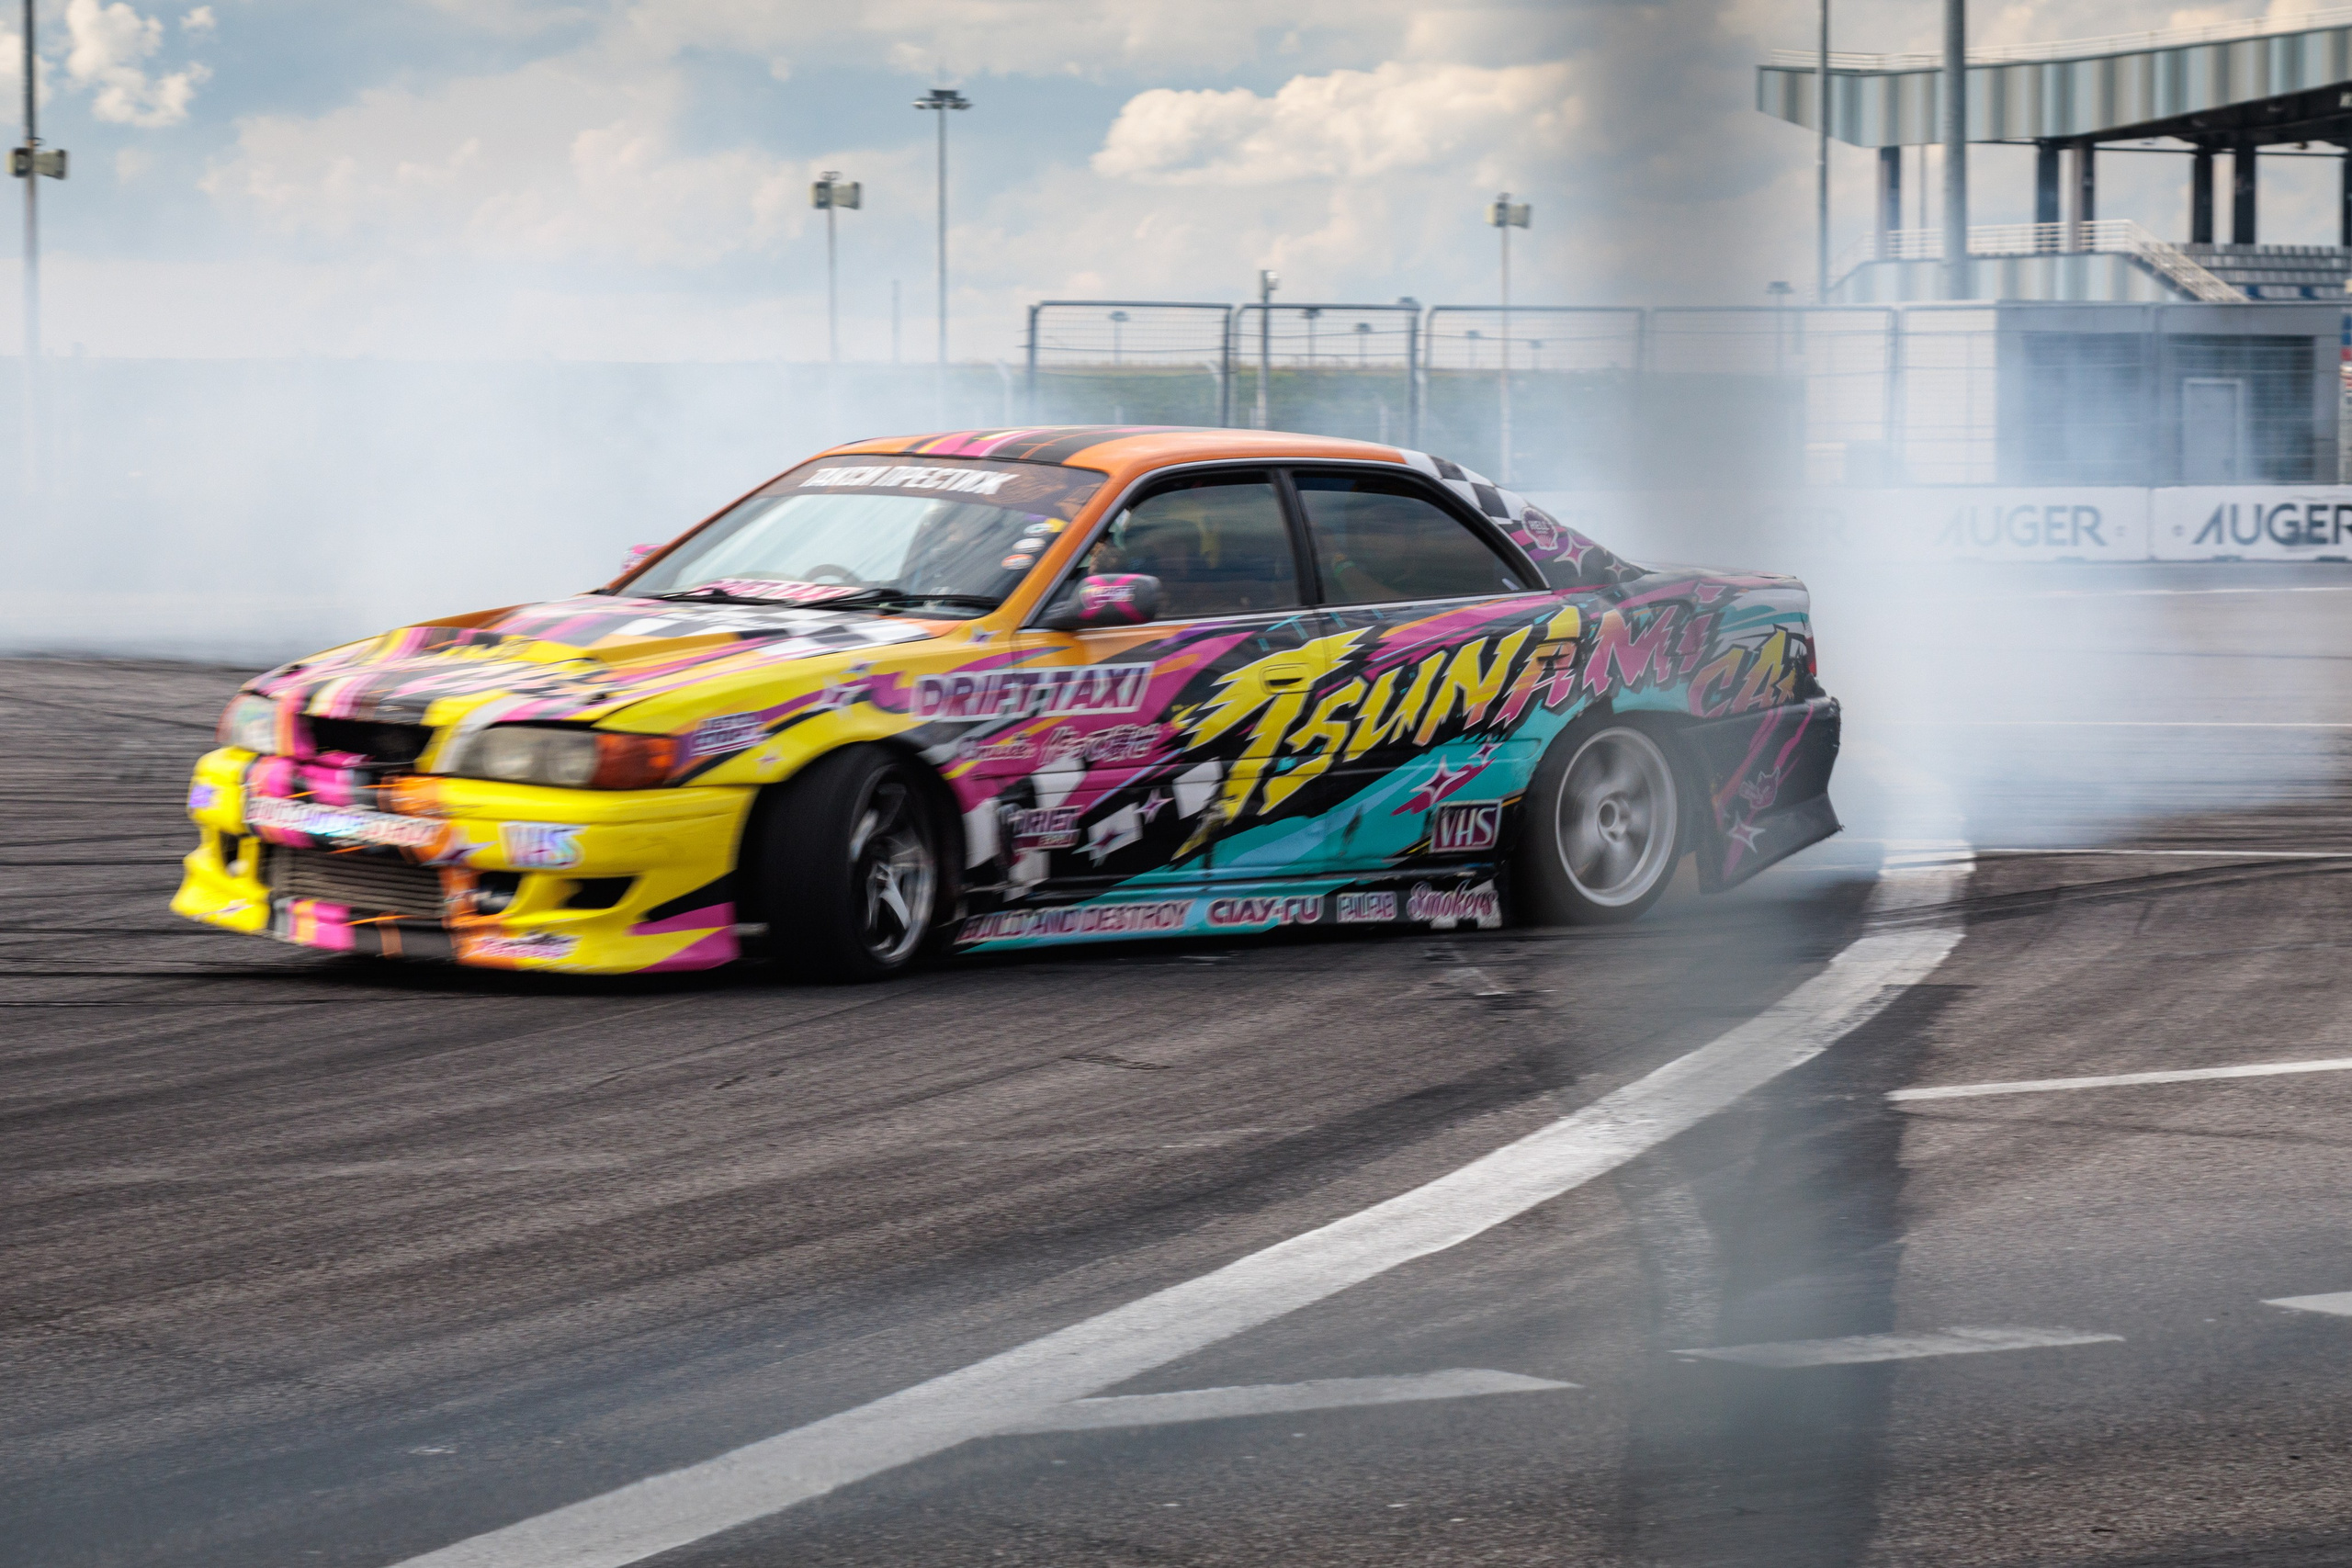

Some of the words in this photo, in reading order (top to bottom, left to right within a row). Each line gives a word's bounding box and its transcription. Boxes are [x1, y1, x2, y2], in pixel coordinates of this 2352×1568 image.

[1934, 504, 2109, 547] AUGER
[1176, 584, 1727, 850] TSUNAMI
[1439, 807, 1498, 848] VHS
